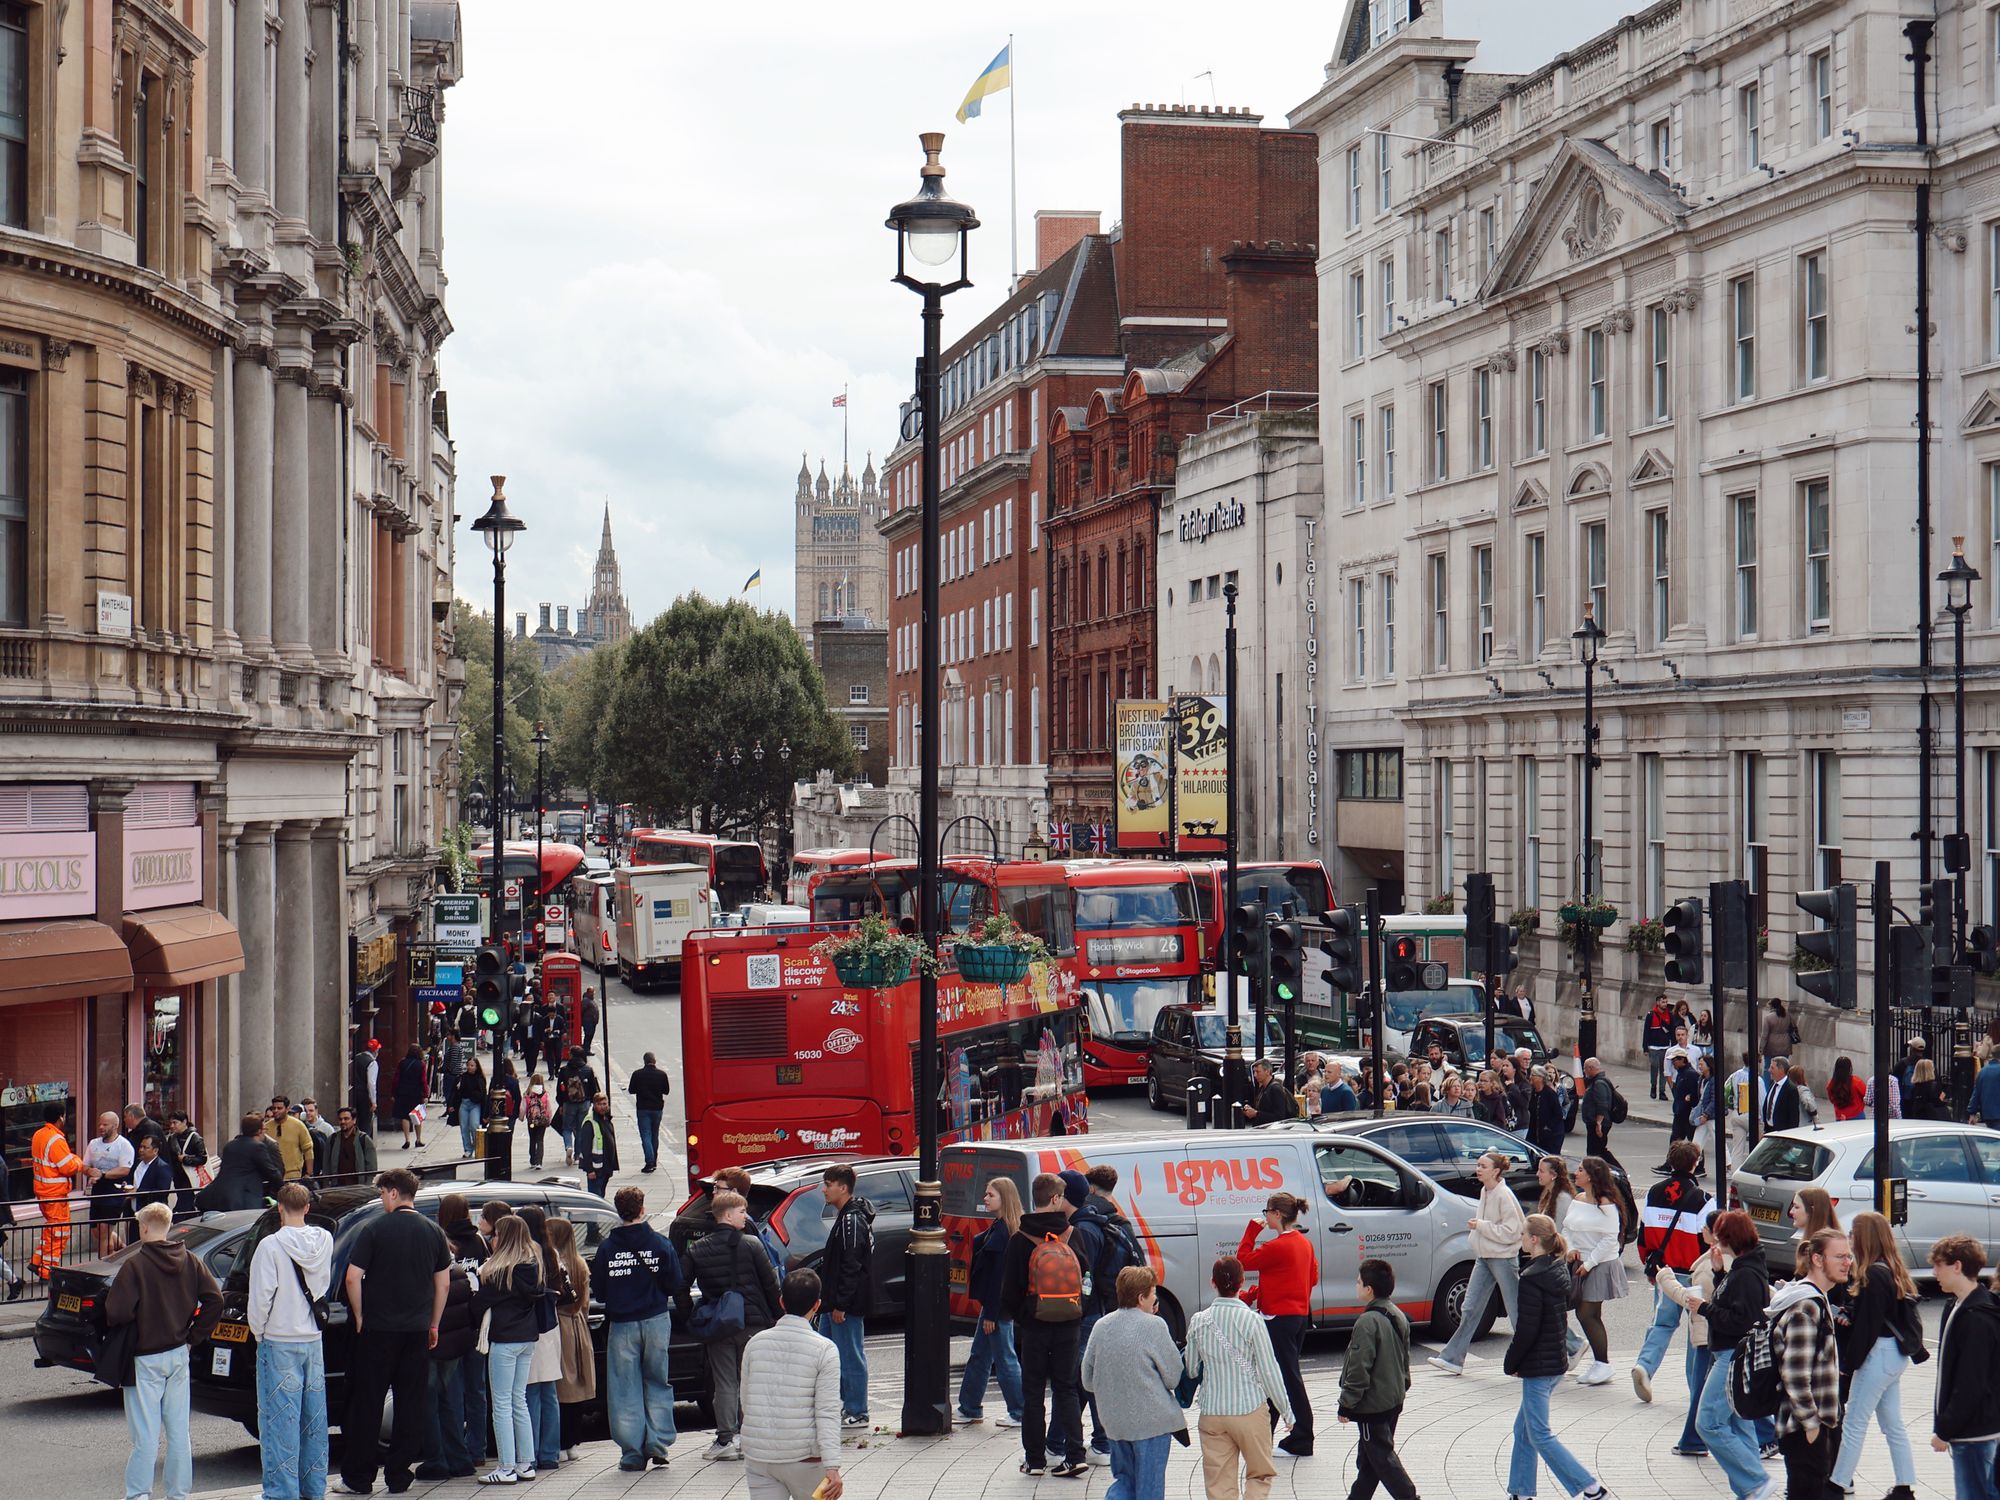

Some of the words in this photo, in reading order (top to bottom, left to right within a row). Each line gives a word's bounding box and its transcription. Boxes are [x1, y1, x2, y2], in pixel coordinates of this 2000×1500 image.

[1179, 506, 1213, 544] Trafalgar
[1211, 497, 1245, 532] Theatre
[101, 598, 129, 611] WHITEHALL
[1305, 520, 1318, 691] Trafalgar
[101, 610, 112, 621] SW1
[1119, 709, 1142, 723] WEST
[1143, 709, 1159, 722] END
[1180, 705, 1200, 718] THE
[1119, 723, 1166, 738] BROADWAY
[1181, 707, 1222, 751] 39
[1119, 738, 1133, 752] HIT
[1133, 737, 1142, 752] IS
[1142, 737, 1167, 752] BACK!
[1194, 737, 1228, 761] STEP
[1306, 705, 1318, 844] Theatre
[132, 852, 193, 885] CHOCOLICIOUS
[0, 859, 82, 894] LICIOUS
[446, 930, 470, 938] MONEY
[1090, 942, 1122, 953] Hackney
[1125, 940, 1145, 950] Wick
[1159, 938, 1179, 953] 26
[783, 957, 810, 968] Scan
[812, 955, 822, 966] &
[783, 966, 828, 977] discover
[1125, 966, 1161, 976] Stagecoach
[783, 977, 802, 986] the
[804, 975, 823, 987] city
[418, 989, 459, 997] EXCHANGE
[830, 999, 847, 1016] 24
[826, 1034, 861, 1050] OFFICIAL
[793, 1049, 823, 1060] 15030
[797, 1129, 828, 1143] City
[830, 1127, 861, 1141] Tour
[737, 1143, 766, 1154] London
[814, 1140, 845, 1150] LONDON
[1209, 1195, 1227, 1206] Fire
[1229, 1192, 1268, 1205] Services
[1365, 1233, 1386, 1242] 01268
[1386, 1232, 1412, 1241] 973370
[608, 1257, 660, 1268] DEPARTENT
